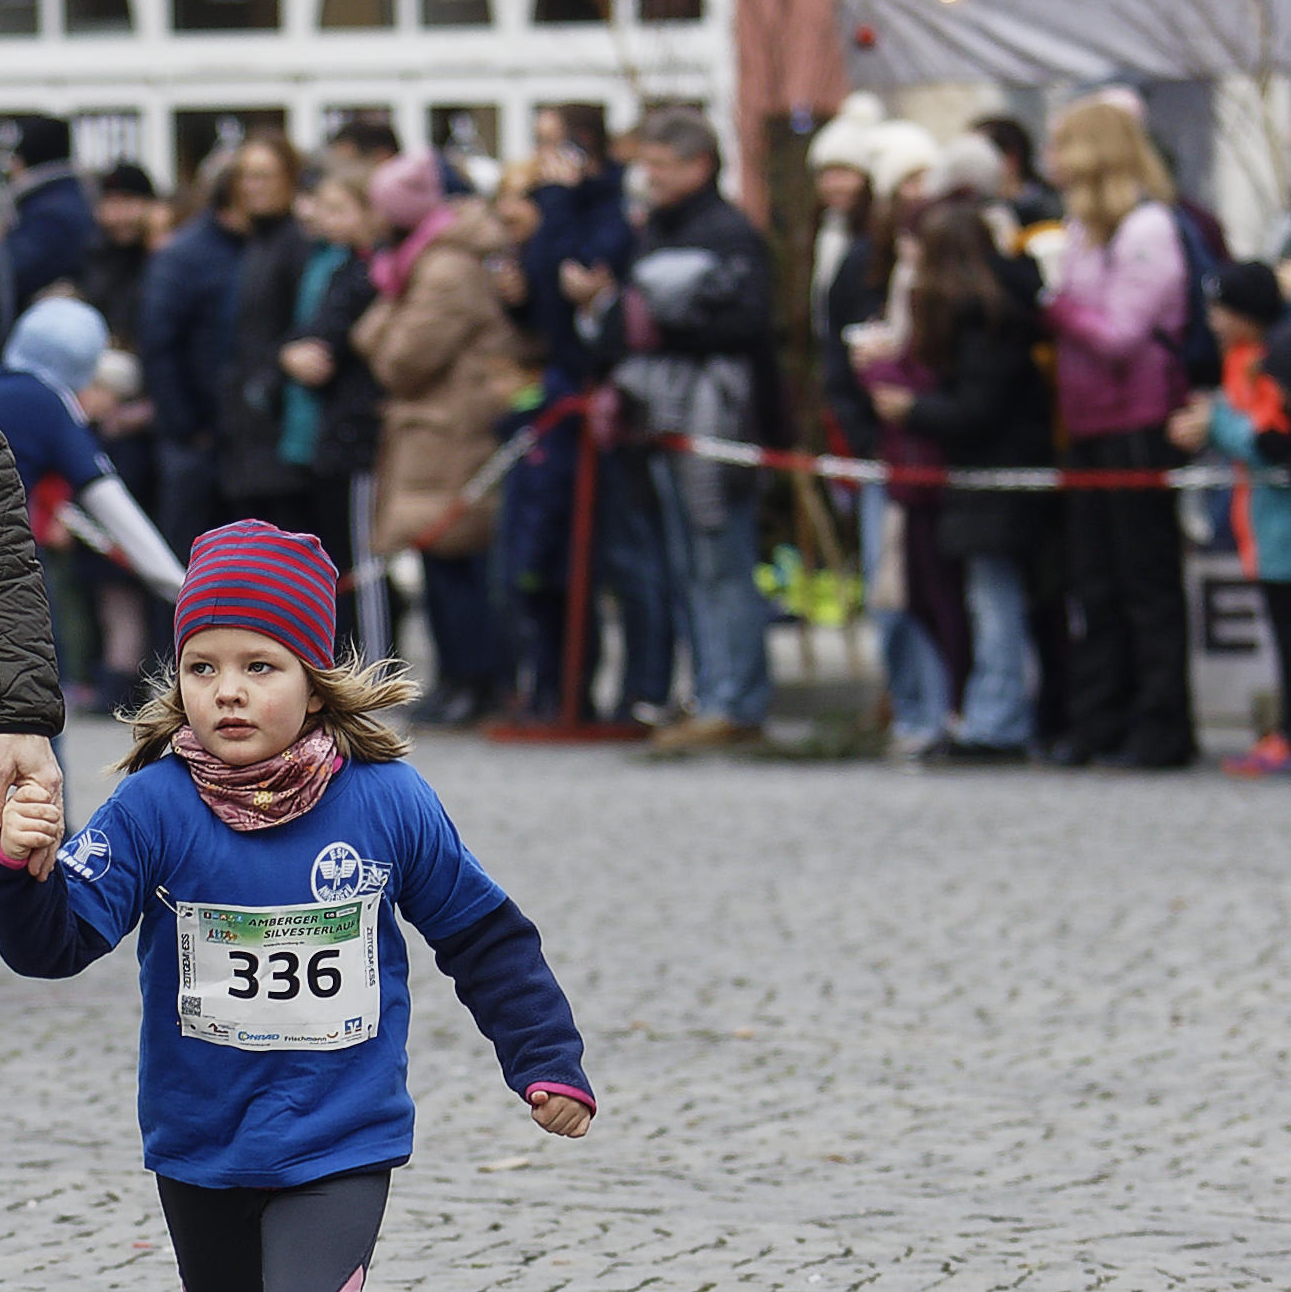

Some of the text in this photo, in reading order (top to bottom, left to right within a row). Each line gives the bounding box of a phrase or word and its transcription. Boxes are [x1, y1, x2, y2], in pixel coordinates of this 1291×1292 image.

[329, 847, 349, 860] ESV
[248, 915, 319, 927] AMBERGER
[263, 920, 356, 939] SILVESTERLAUF
[228, 949, 342, 1000] 336
